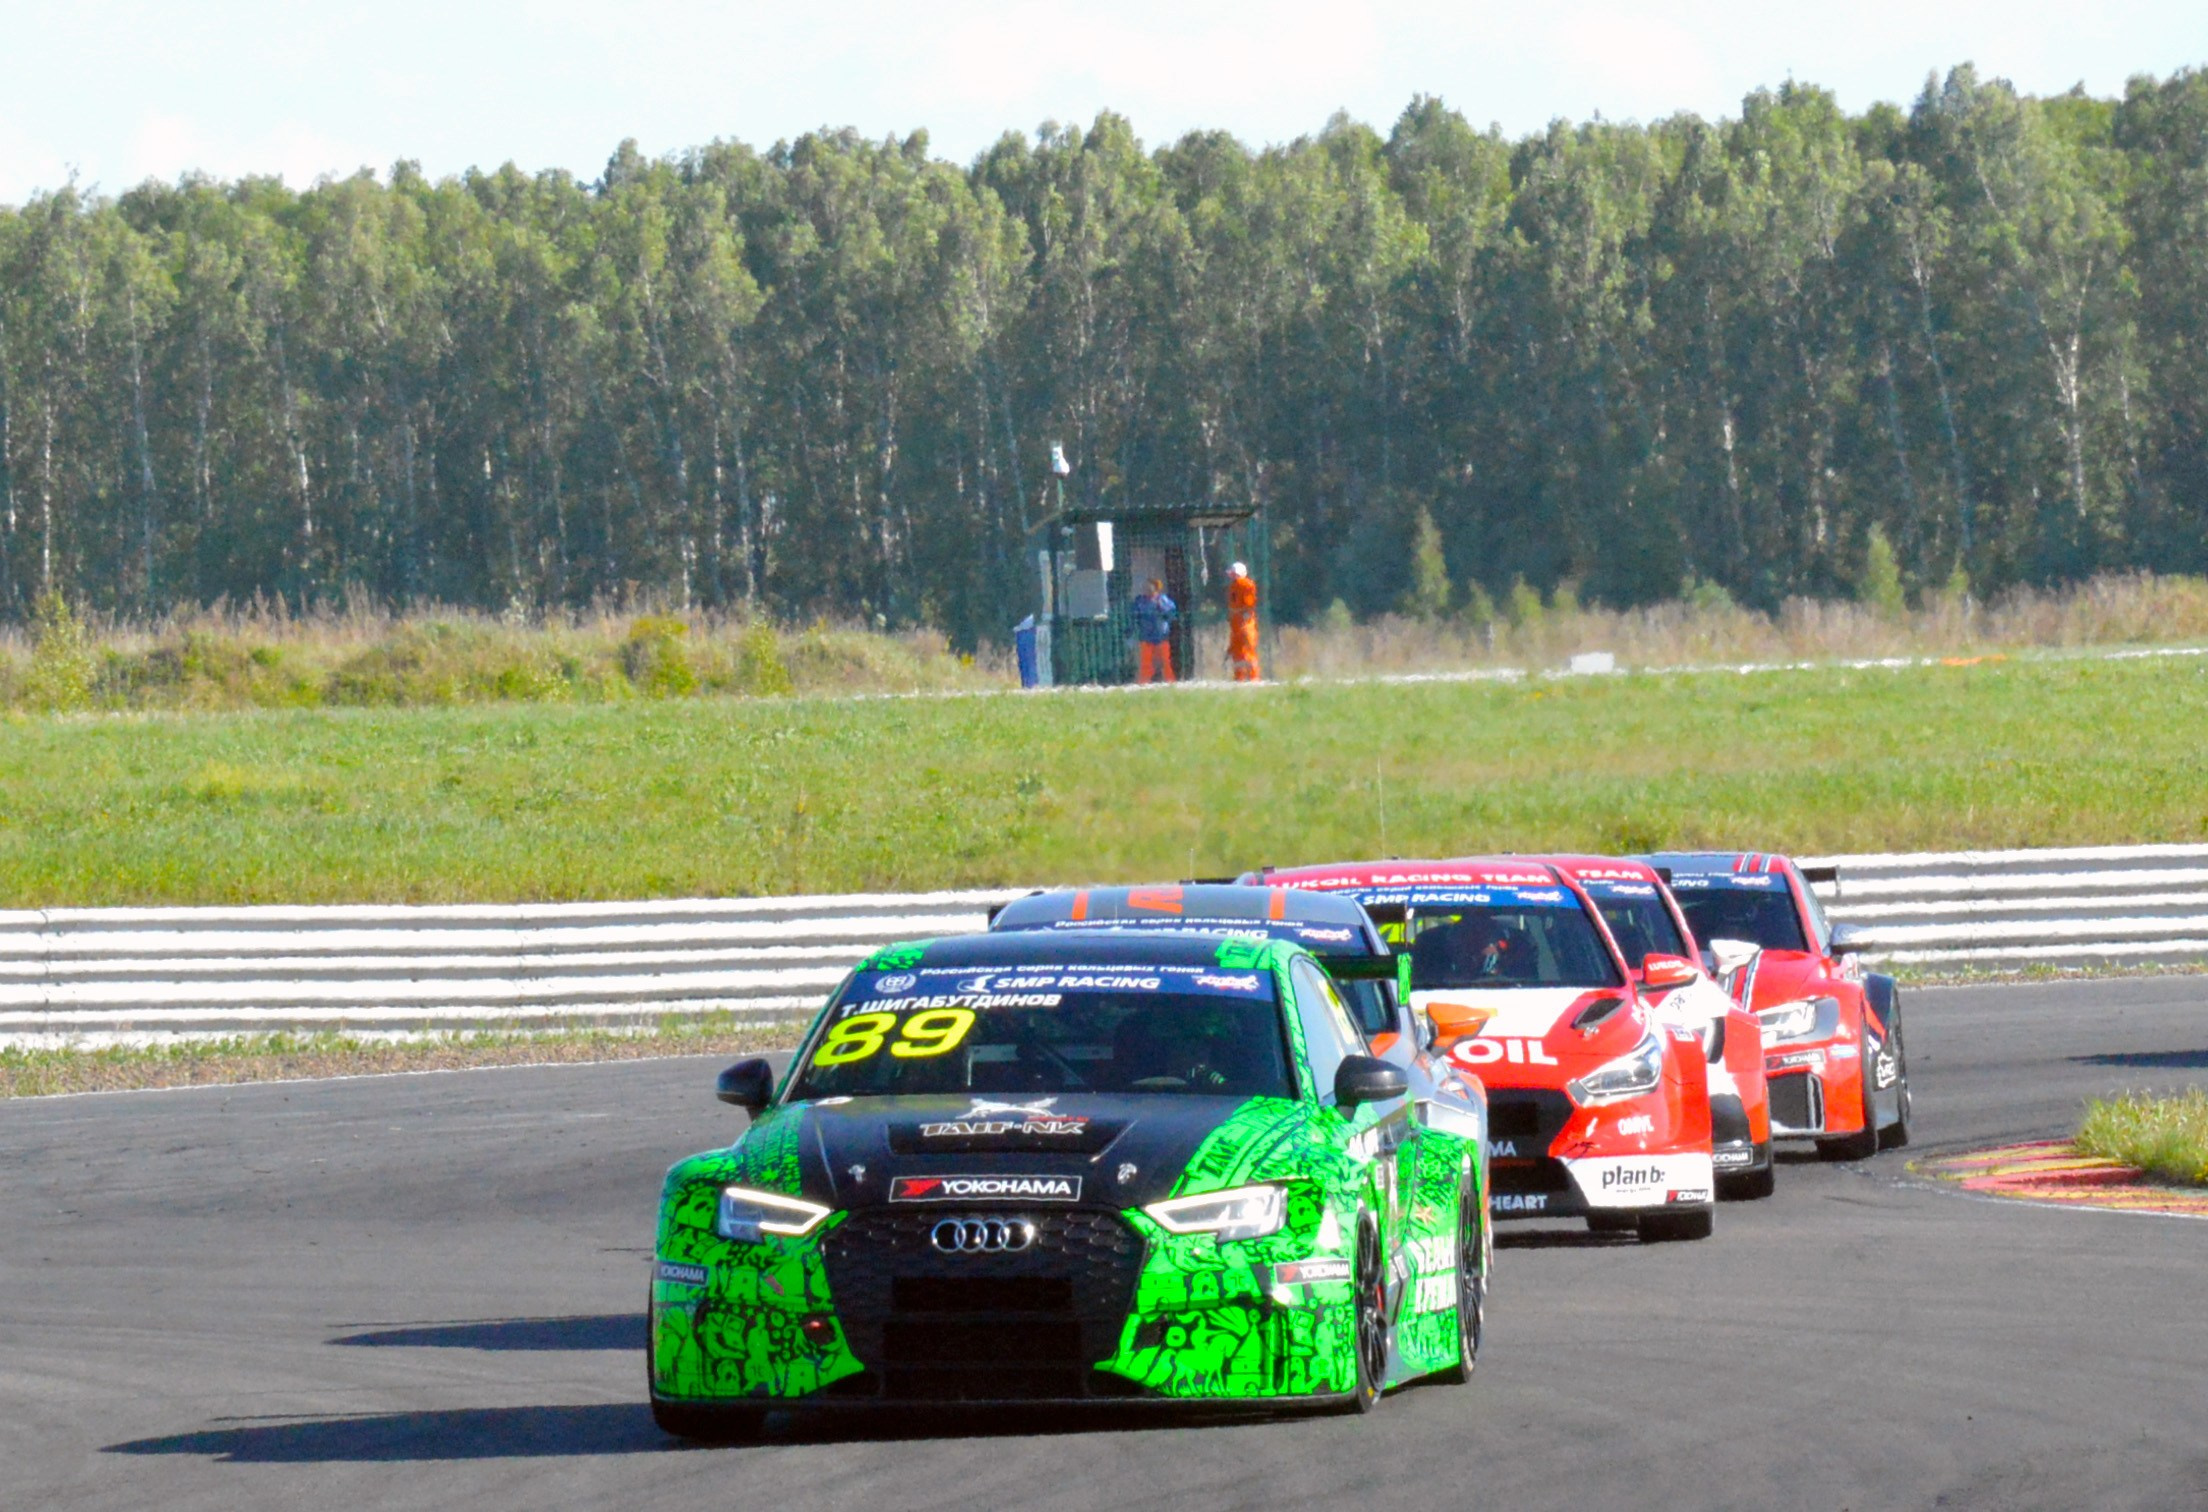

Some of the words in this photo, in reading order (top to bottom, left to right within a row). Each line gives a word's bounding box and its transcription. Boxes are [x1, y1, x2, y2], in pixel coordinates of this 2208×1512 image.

[1269, 878, 1362, 890] UKOIL
[1371, 874, 1472, 883] RACING
[1481, 873, 1552, 883] TEAM
[1576, 869, 1644, 880] TEAM
[1671, 879, 1709, 887] CING
[1363, 893, 1409, 905] SMP
[1411, 893, 1491, 903] RACING
[993, 976, 1056, 989] SMP
[1057, 976, 1161, 990] RACING
[841, 993, 1062, 1019] Т.ШИГАБУТДИНОВ
[813, 1008, 977, 1067] 89
[1443, 1038, 1559, 1066] OIL
[920, 1120, 1086, 1137] TAIF-NK
[1602, 1165, 1647, 1189] plan
[942, 1179, 1071, 1194] YOKOHAMA
